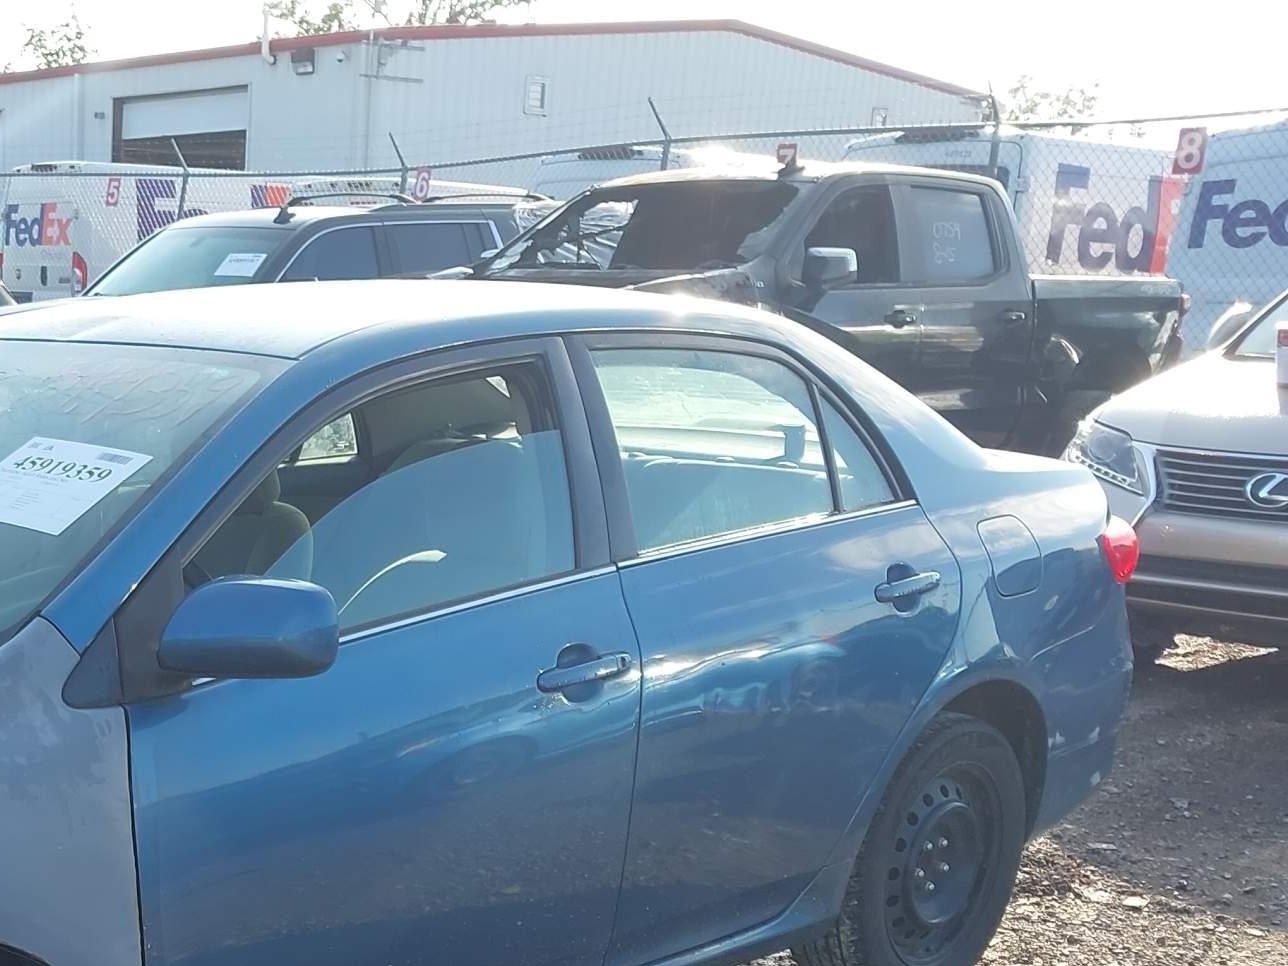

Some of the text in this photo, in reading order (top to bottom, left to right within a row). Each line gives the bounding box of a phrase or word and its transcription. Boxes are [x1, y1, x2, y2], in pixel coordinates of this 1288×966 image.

[1176, 131, 1203, 169] 8
[107, 180, 120, 204] 5
[415, 171, 430, 199] 6
[4, 202, 73, 247] FedEx
[13, 455, 112, 482] 45919359
